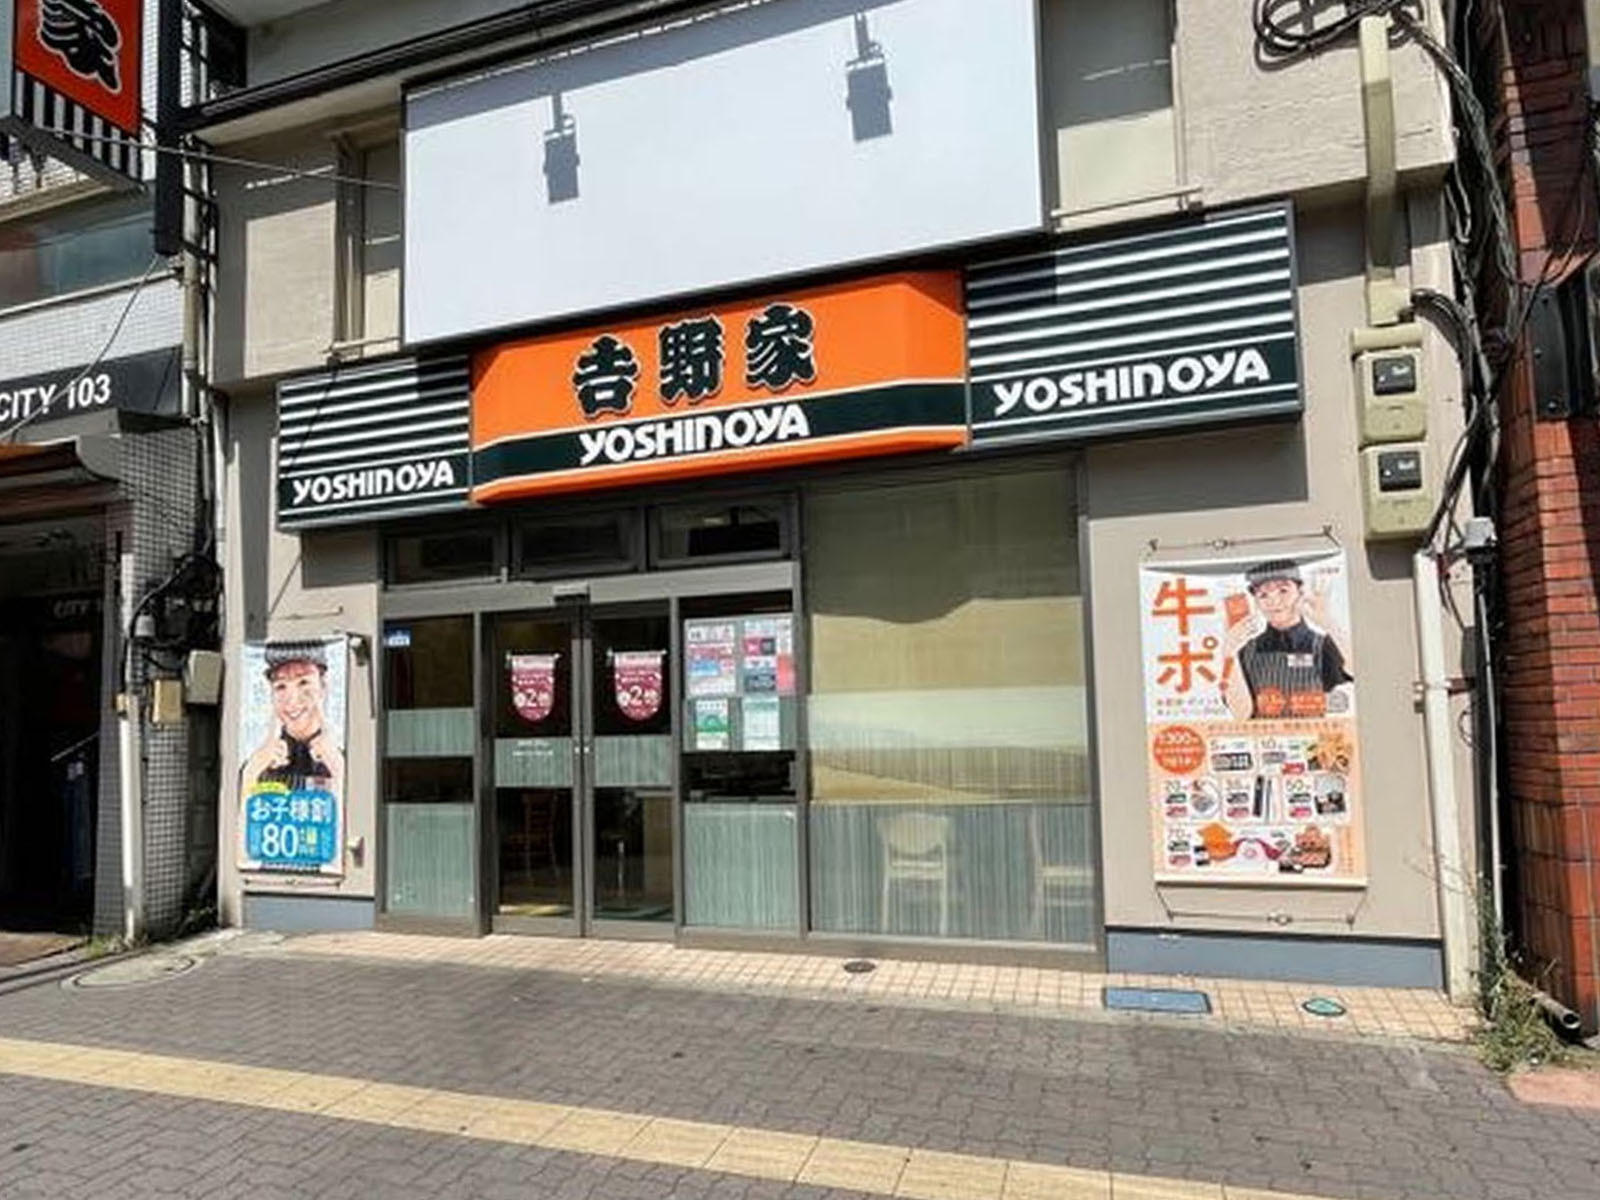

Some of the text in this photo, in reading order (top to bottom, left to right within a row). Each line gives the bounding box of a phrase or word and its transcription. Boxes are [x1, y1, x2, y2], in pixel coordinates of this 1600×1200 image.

[573, 304, 816, 419] 吉野家
[67, 374, 110, 409] 103
[262, 823, 298, 858] 80
